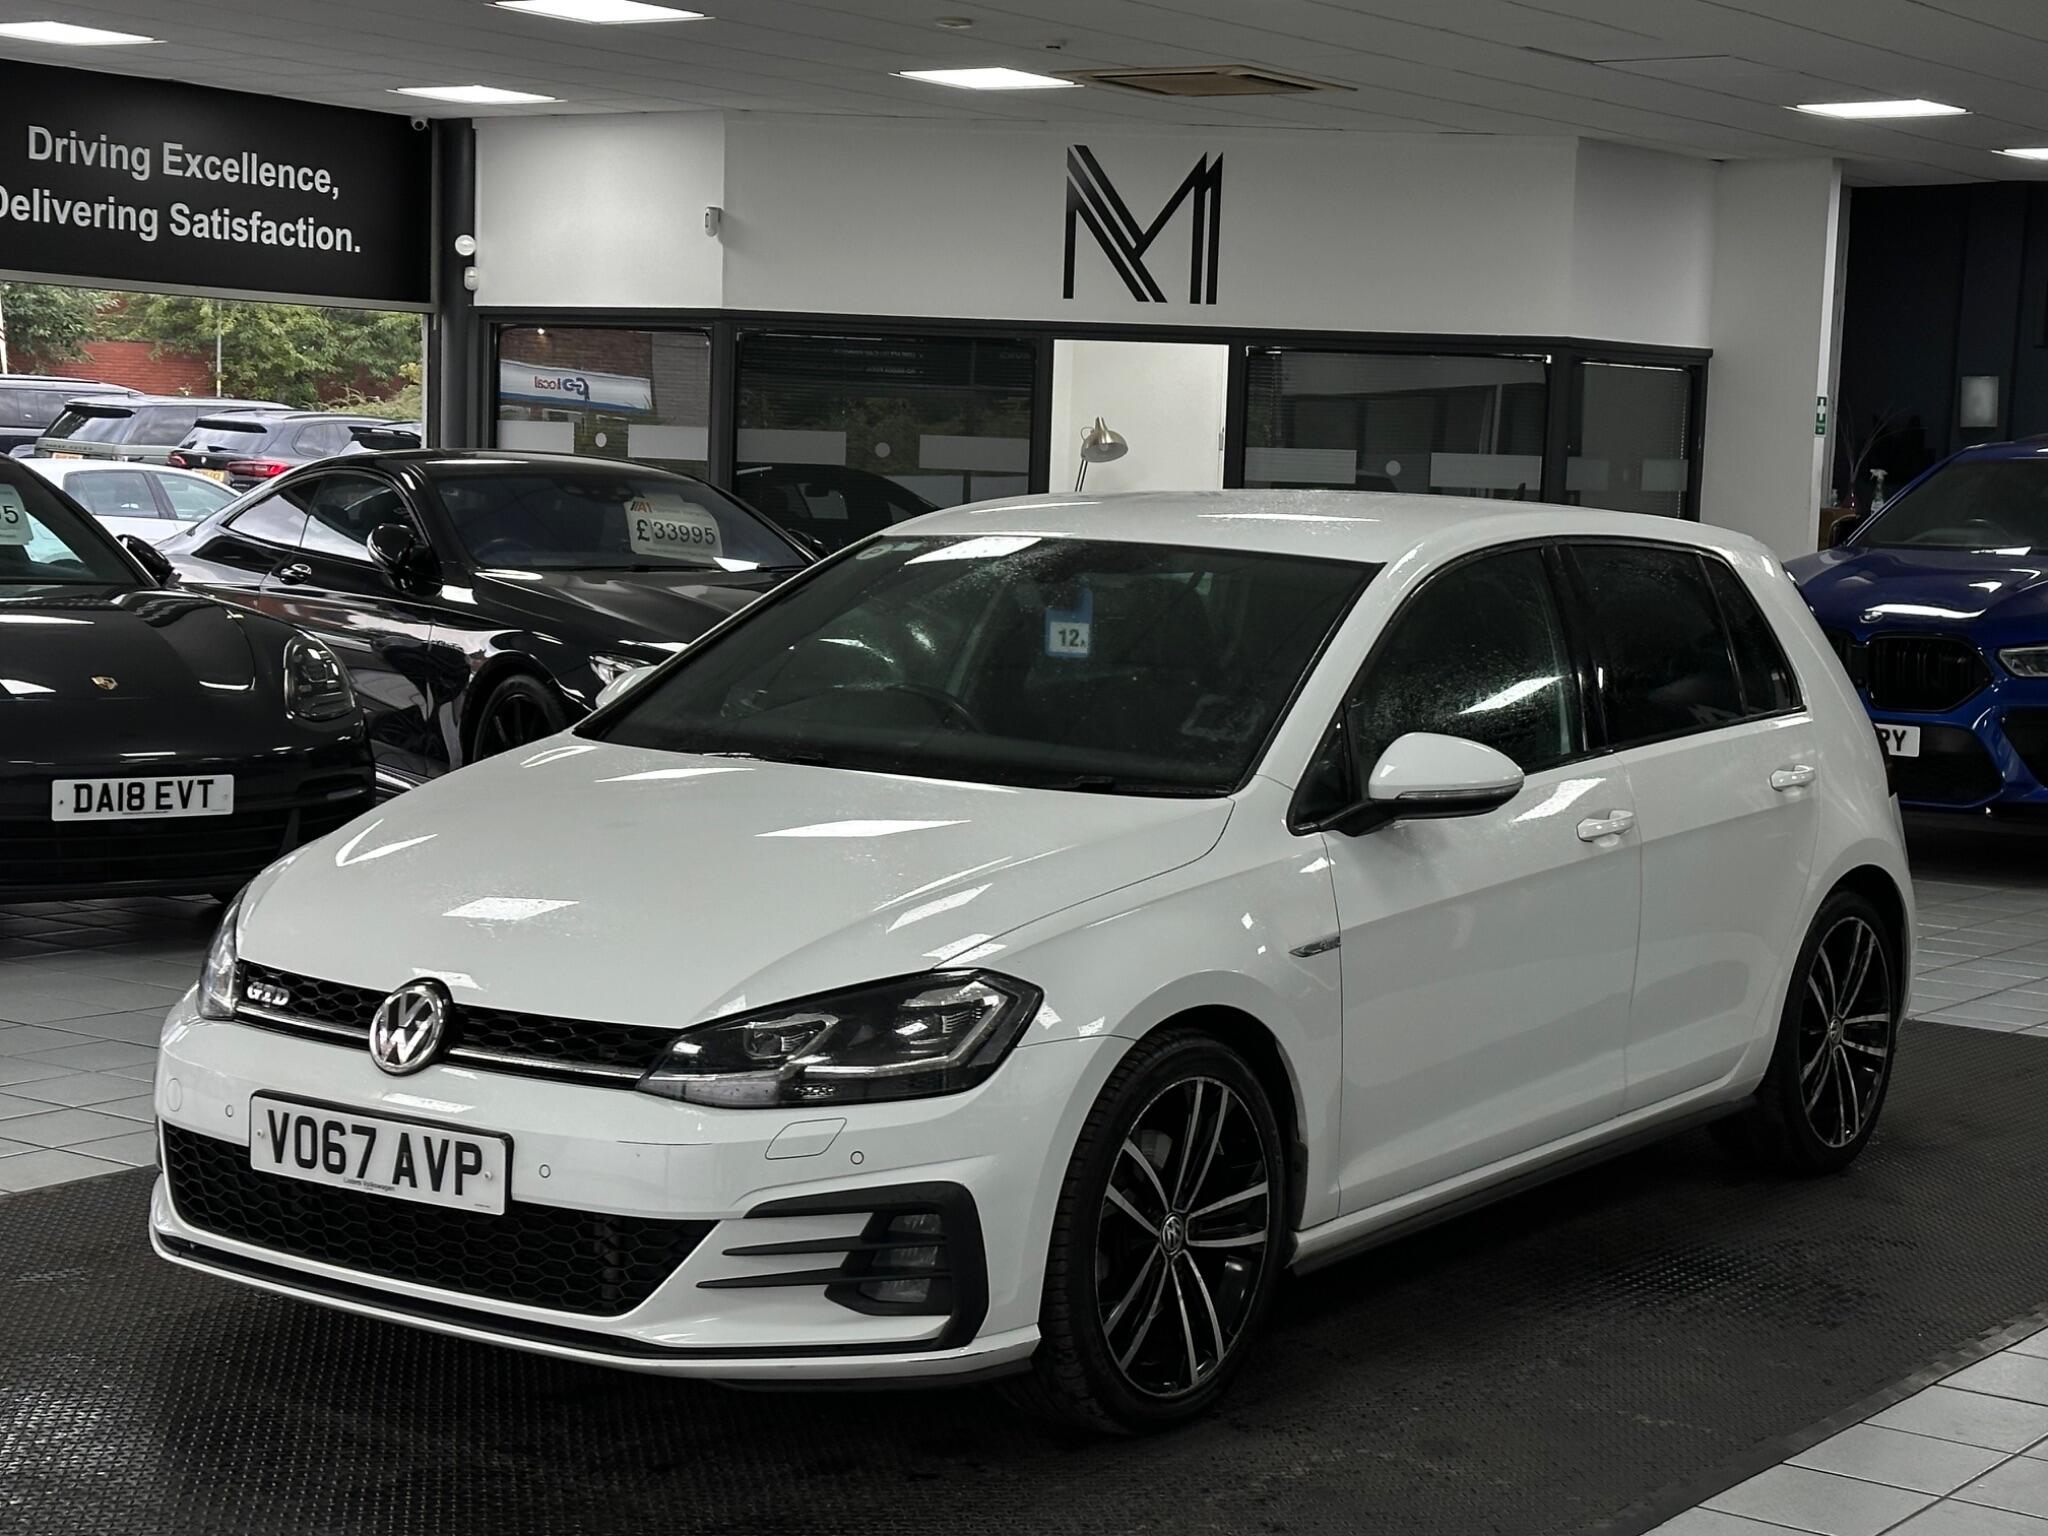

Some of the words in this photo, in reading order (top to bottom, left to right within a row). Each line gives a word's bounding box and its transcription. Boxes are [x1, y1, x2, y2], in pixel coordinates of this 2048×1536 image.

[28, 125, 150, 181] Driving
[163, 142, 339, 200] Excellence,
[170, 202, 361, 252] Satisfaction.
[0, 505, 18, 524] 5
[636, 519, 716, 545] £33995
[73, 781, 145, 813] DA18
[155, 779, 214, 810] EVT
[391, 1132, 482, 1197] AVP
